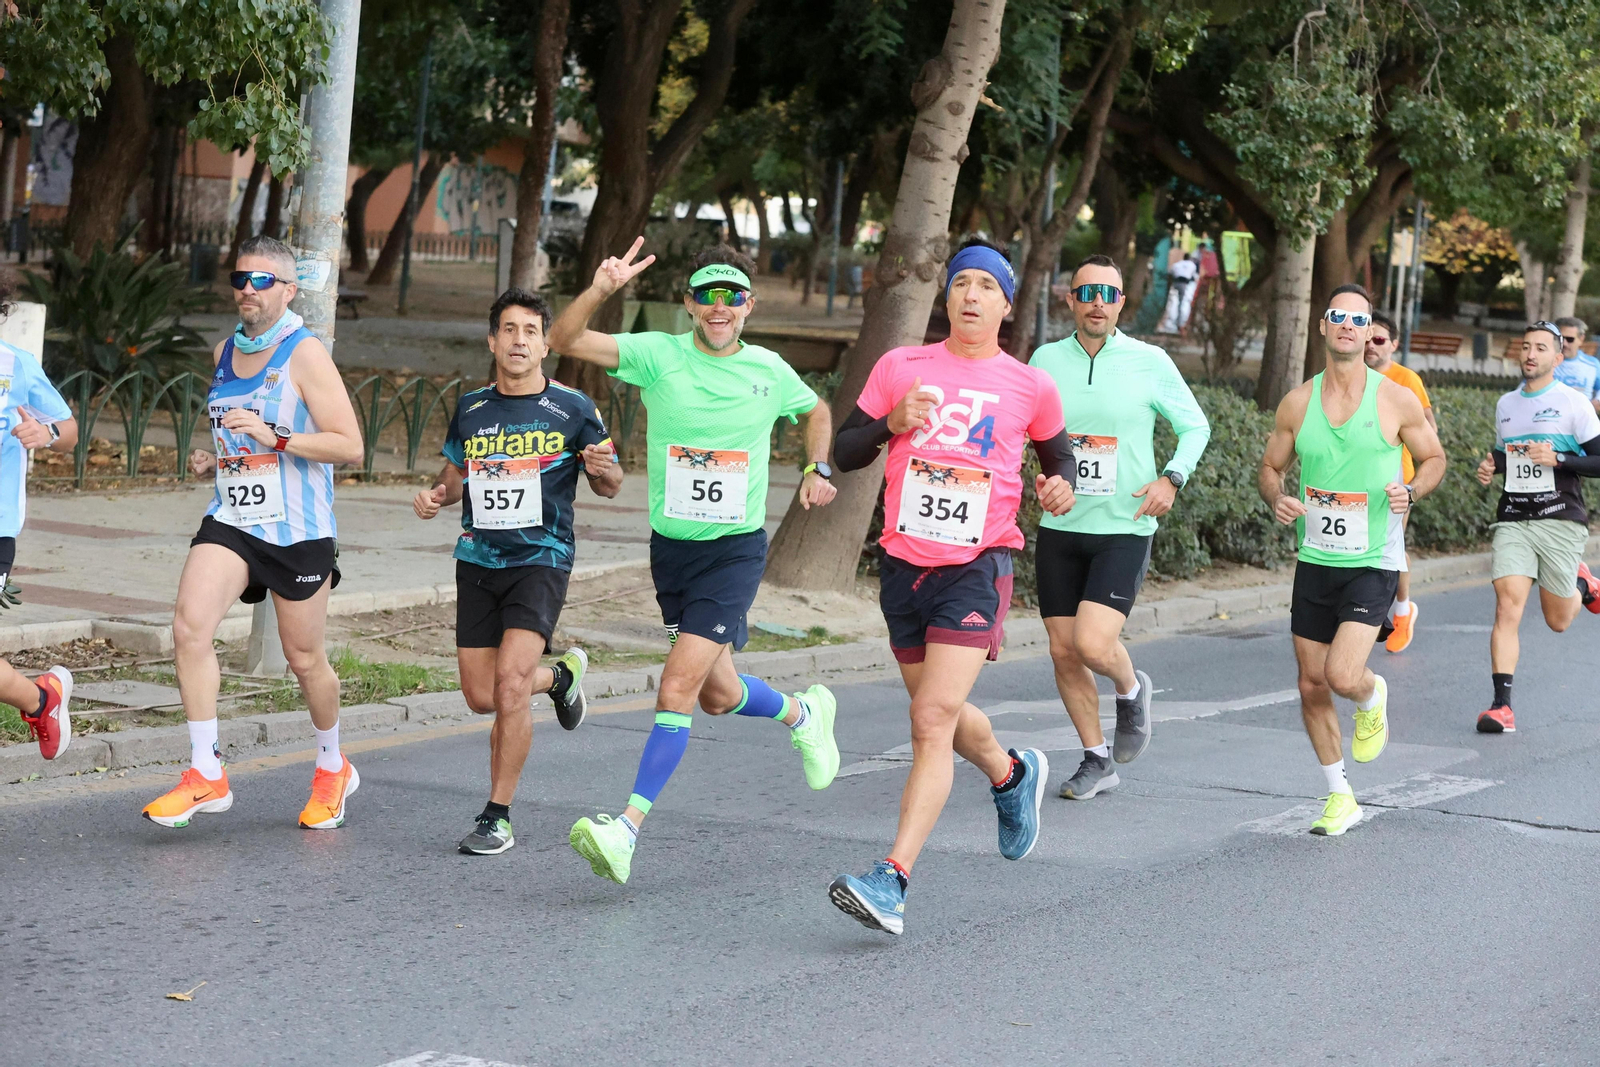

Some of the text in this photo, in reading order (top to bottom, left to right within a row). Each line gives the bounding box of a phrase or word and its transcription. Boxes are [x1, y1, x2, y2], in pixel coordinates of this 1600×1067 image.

[547, 403, 571, 420] Deportes
[477, 423, 500, 436] trail
[941, 445, 980, 456] DEPORTIVO
[1516, 464, 1542, 479] 196
[227, 484, 266, 507] 529
[484, 488, 525, 510] 557
[691, 479, 723, 503] 56
[918, 494, 969, 524] 354
[1321, 516, 1347, 537] 26
[295, 574, 322, 583] Joma
